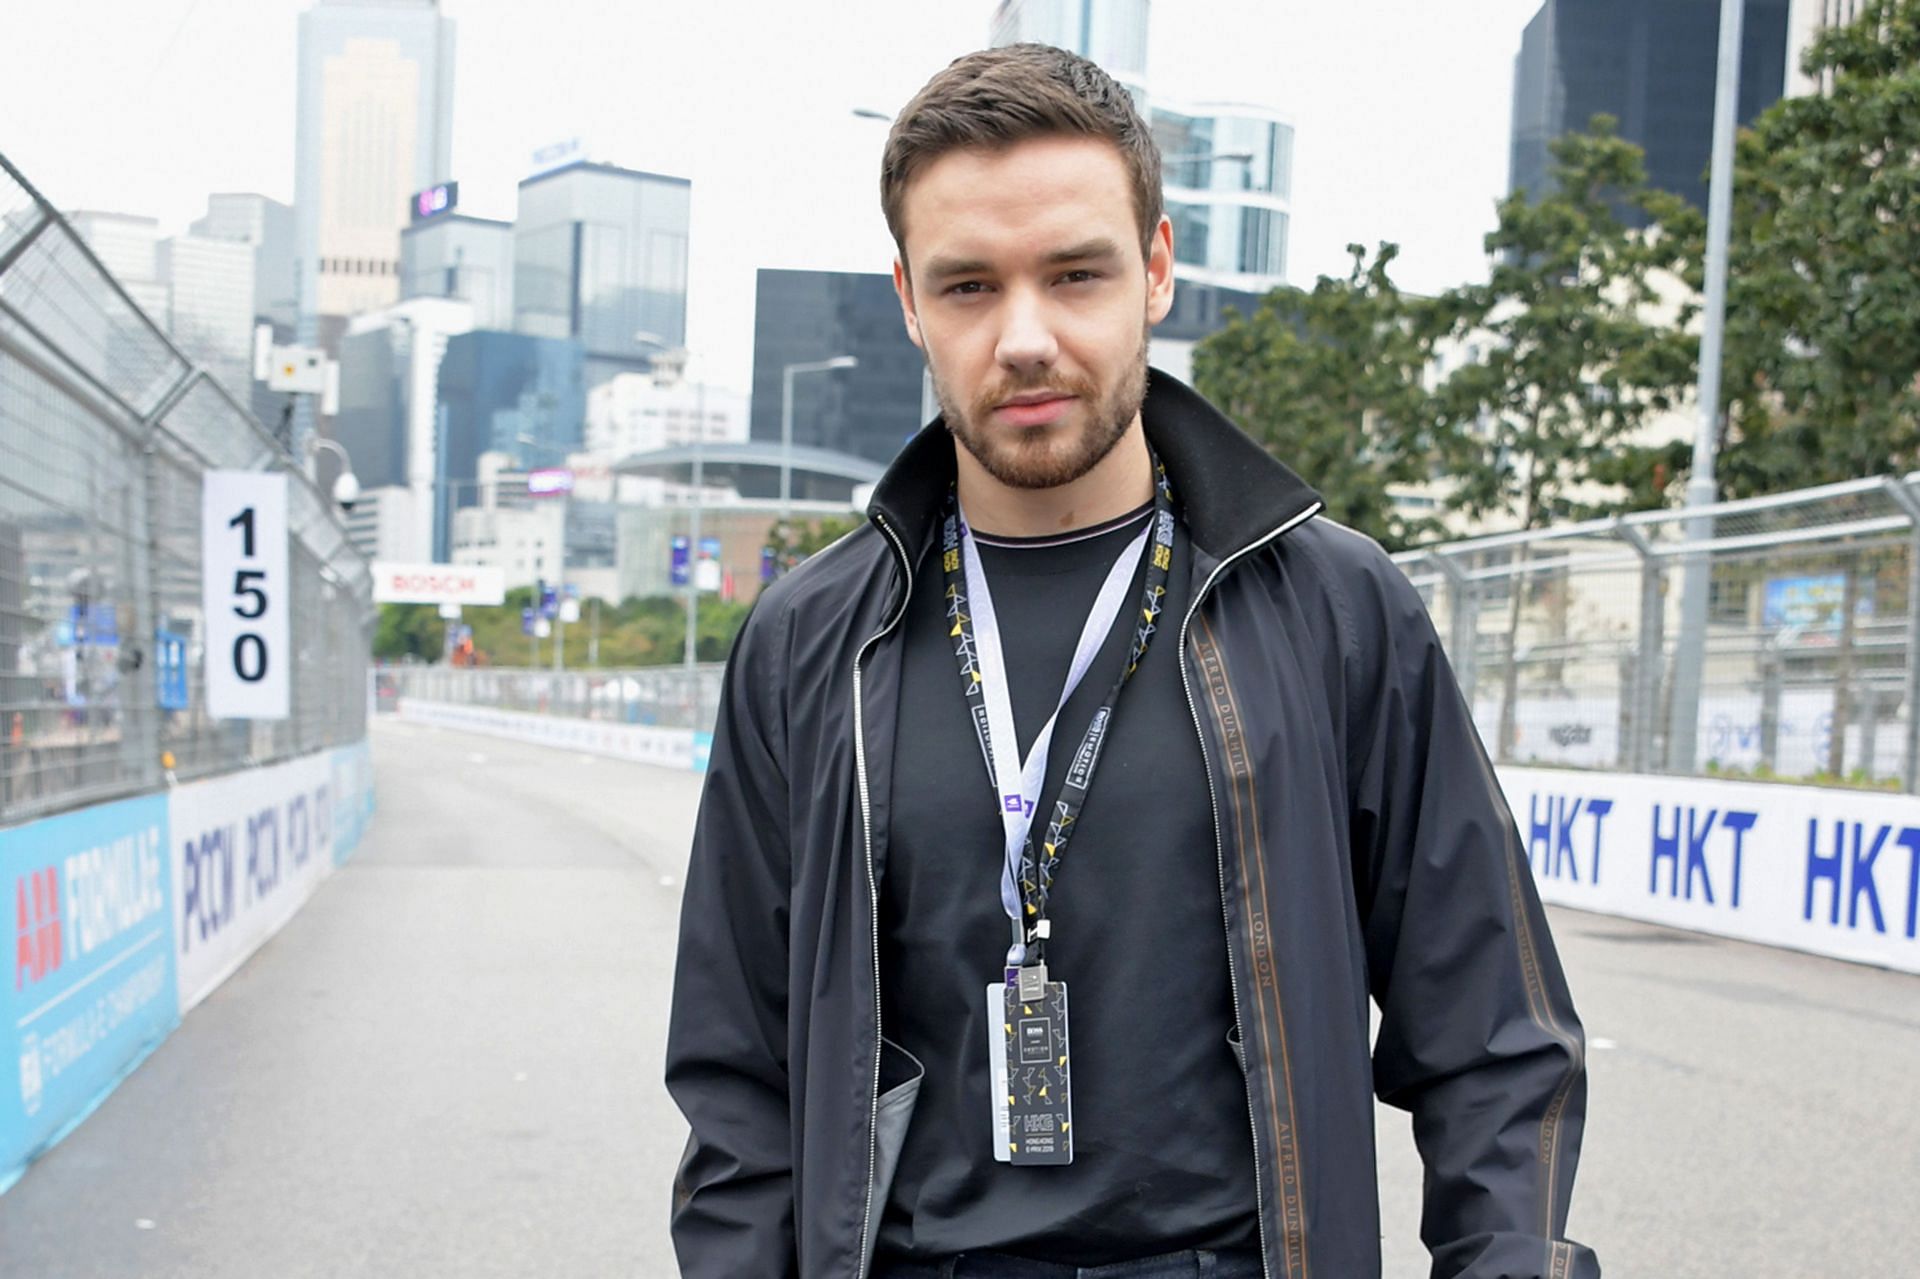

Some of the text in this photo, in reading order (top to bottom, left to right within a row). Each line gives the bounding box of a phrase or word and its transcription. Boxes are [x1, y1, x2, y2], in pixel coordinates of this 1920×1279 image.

[228, 507, 268, 682] 150
[392, 574, 475, 594] BOSCH
[1221, 704, 1247, 777] DUNHILL
[1527, 793, 1614, 886] HKT
[1649, 803, 1759, 908] HKT
[1252, 911, 1271, 988] LONDON
